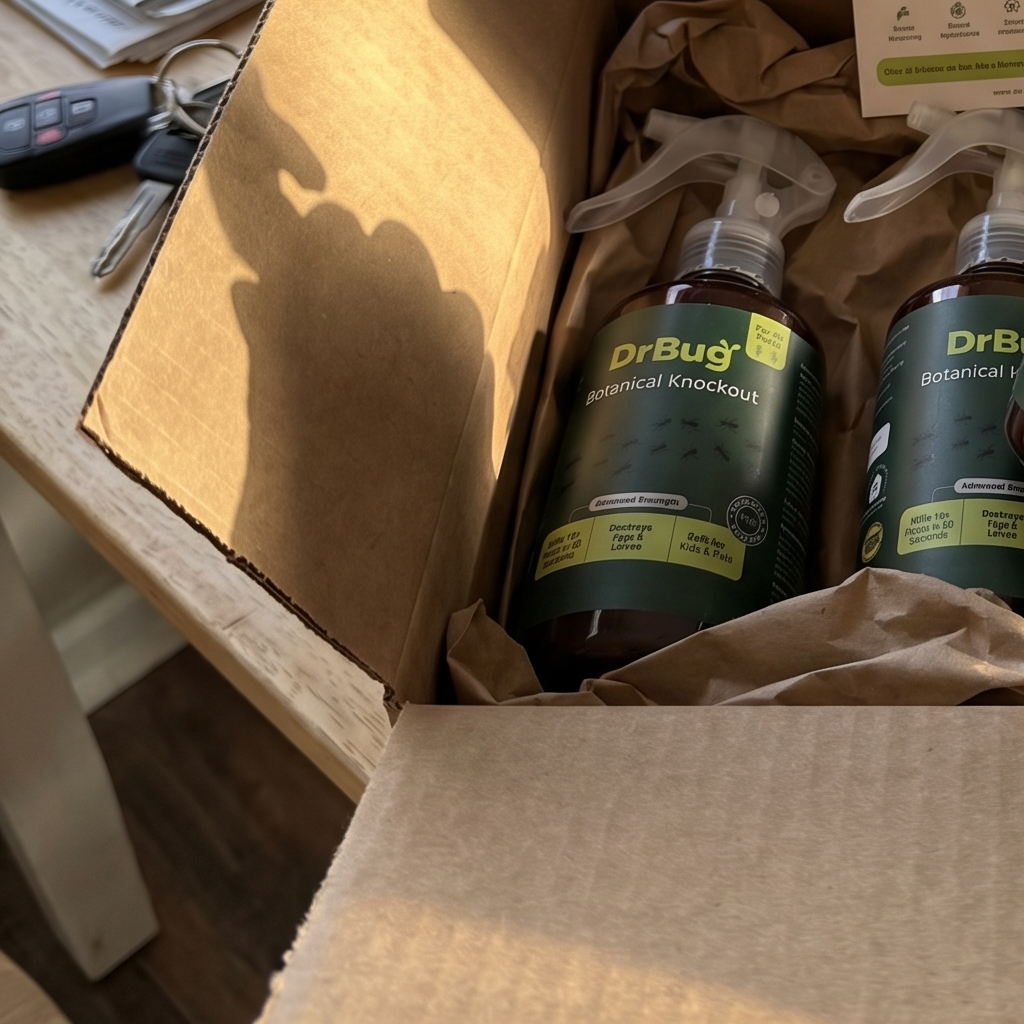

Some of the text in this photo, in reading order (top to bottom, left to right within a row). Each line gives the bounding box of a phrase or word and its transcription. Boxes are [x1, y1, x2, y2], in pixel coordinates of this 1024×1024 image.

[608, 337, 742, 372] DrBug
[585, 374, 760, 406] Botanical Knockout
[921, 364, 1004, 387] Botanical
